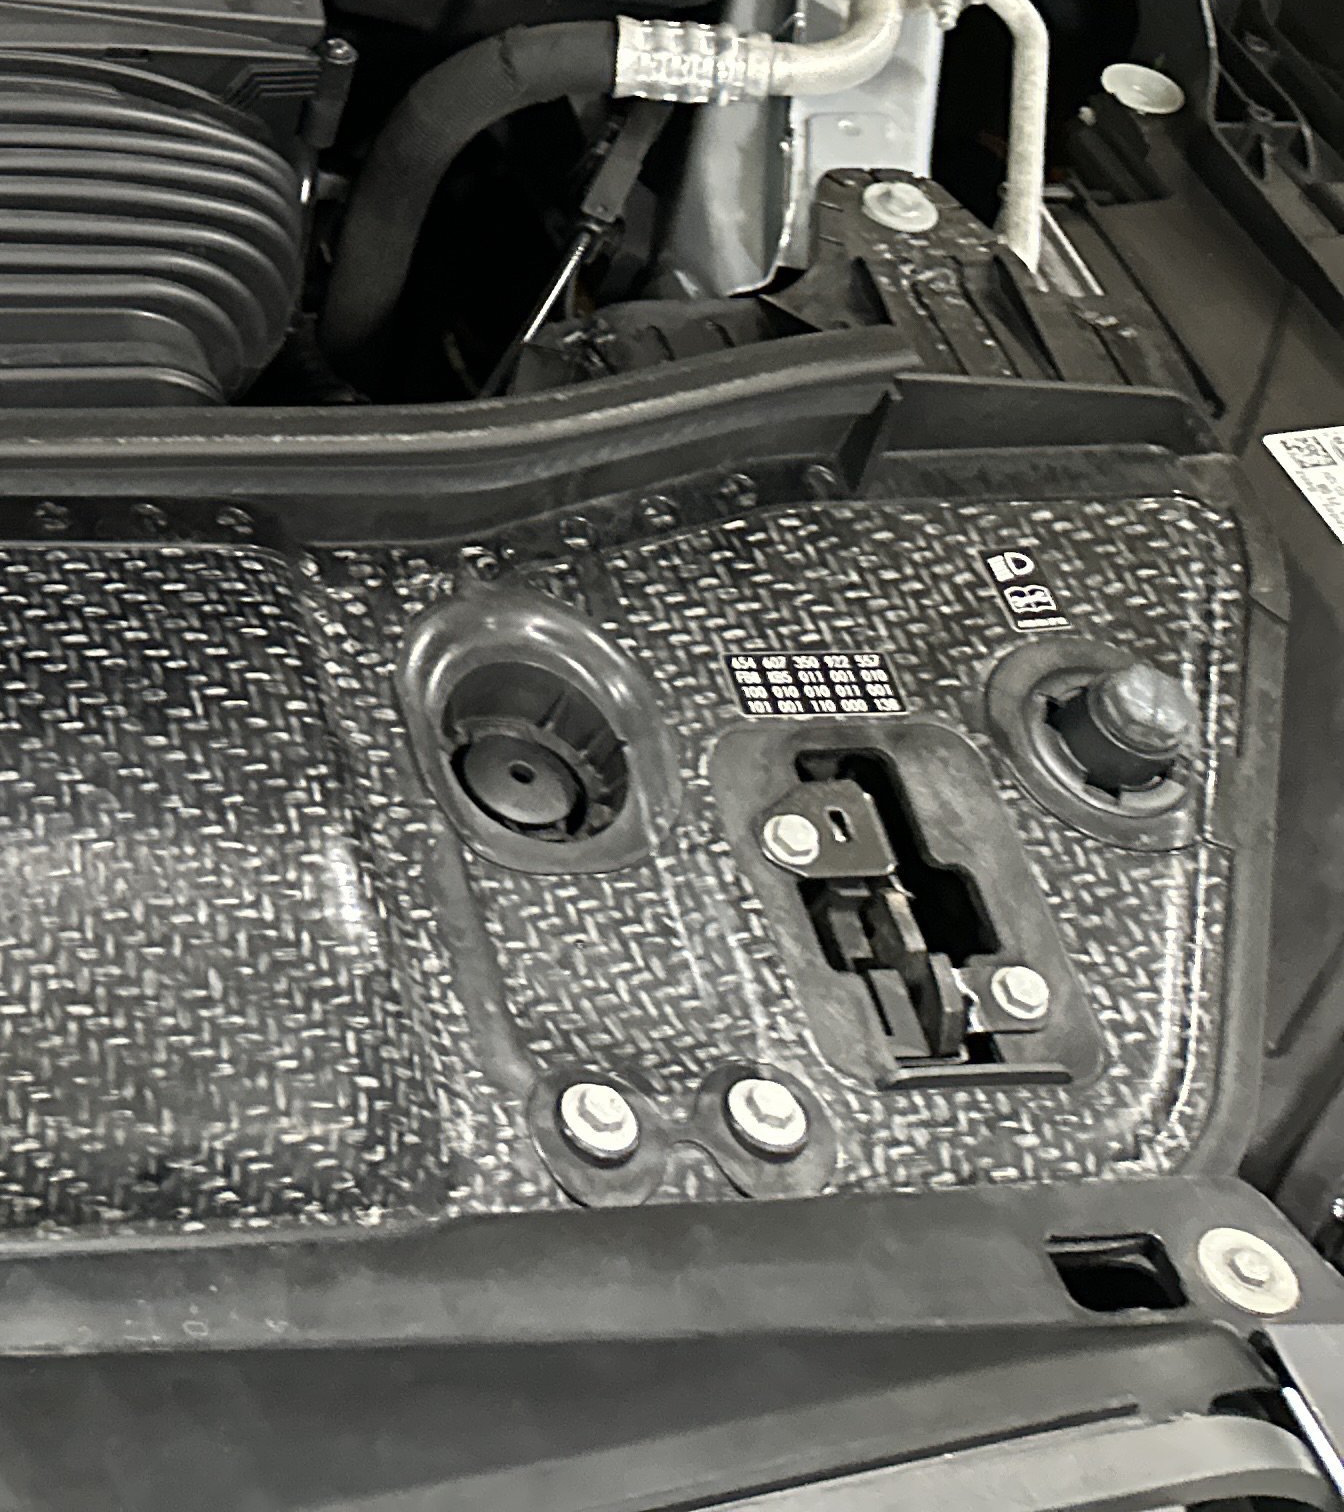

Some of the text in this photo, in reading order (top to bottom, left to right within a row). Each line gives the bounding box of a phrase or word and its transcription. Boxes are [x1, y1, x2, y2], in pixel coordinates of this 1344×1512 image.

[798, 671, 825, 684] 011
[829, 670, 856, 683] 001
[860, 670, 889, 682] 010
[741, 684, 893, 698] 100 010 010 011 001
[746, 701, 773, 713] 101
[777, 700, 804, 713] 001
[811, 700, 837, 712] 110
[840, 700, 868, 712] 000
